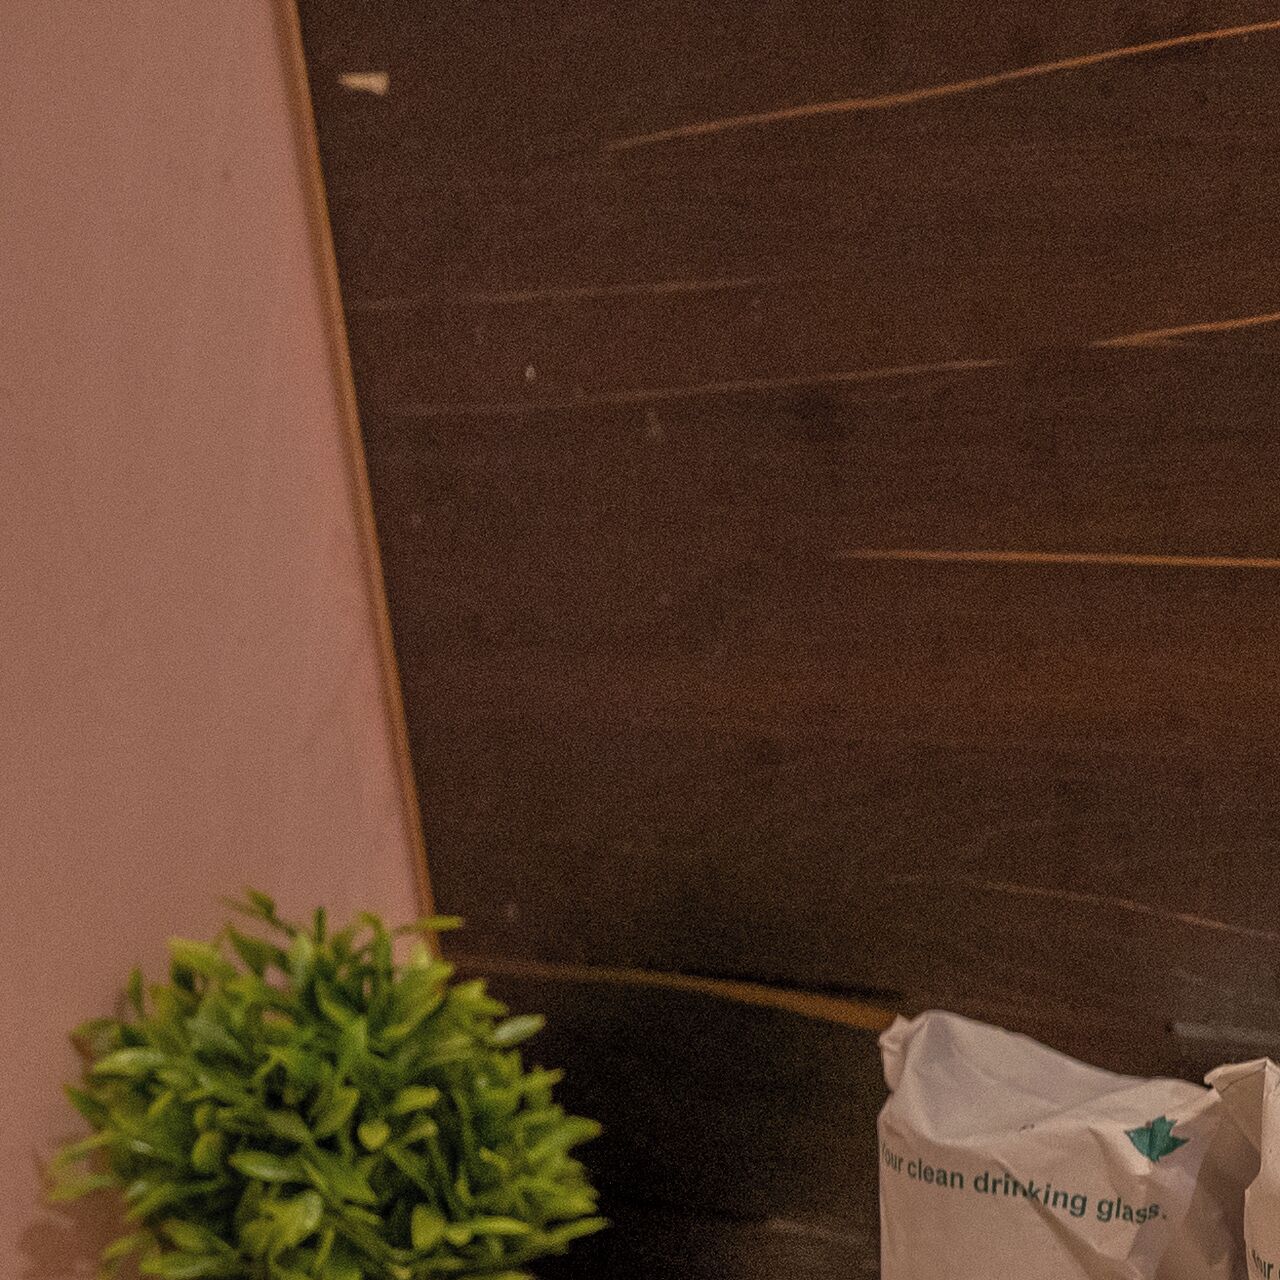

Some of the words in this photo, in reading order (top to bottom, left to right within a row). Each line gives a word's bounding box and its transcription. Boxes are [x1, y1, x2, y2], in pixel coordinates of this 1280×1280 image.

[907, 1157, 964, 1190] clean
[973, 1171, 1088, 1218] drinking
[1096, 1196, 1167, 1225] glass.
